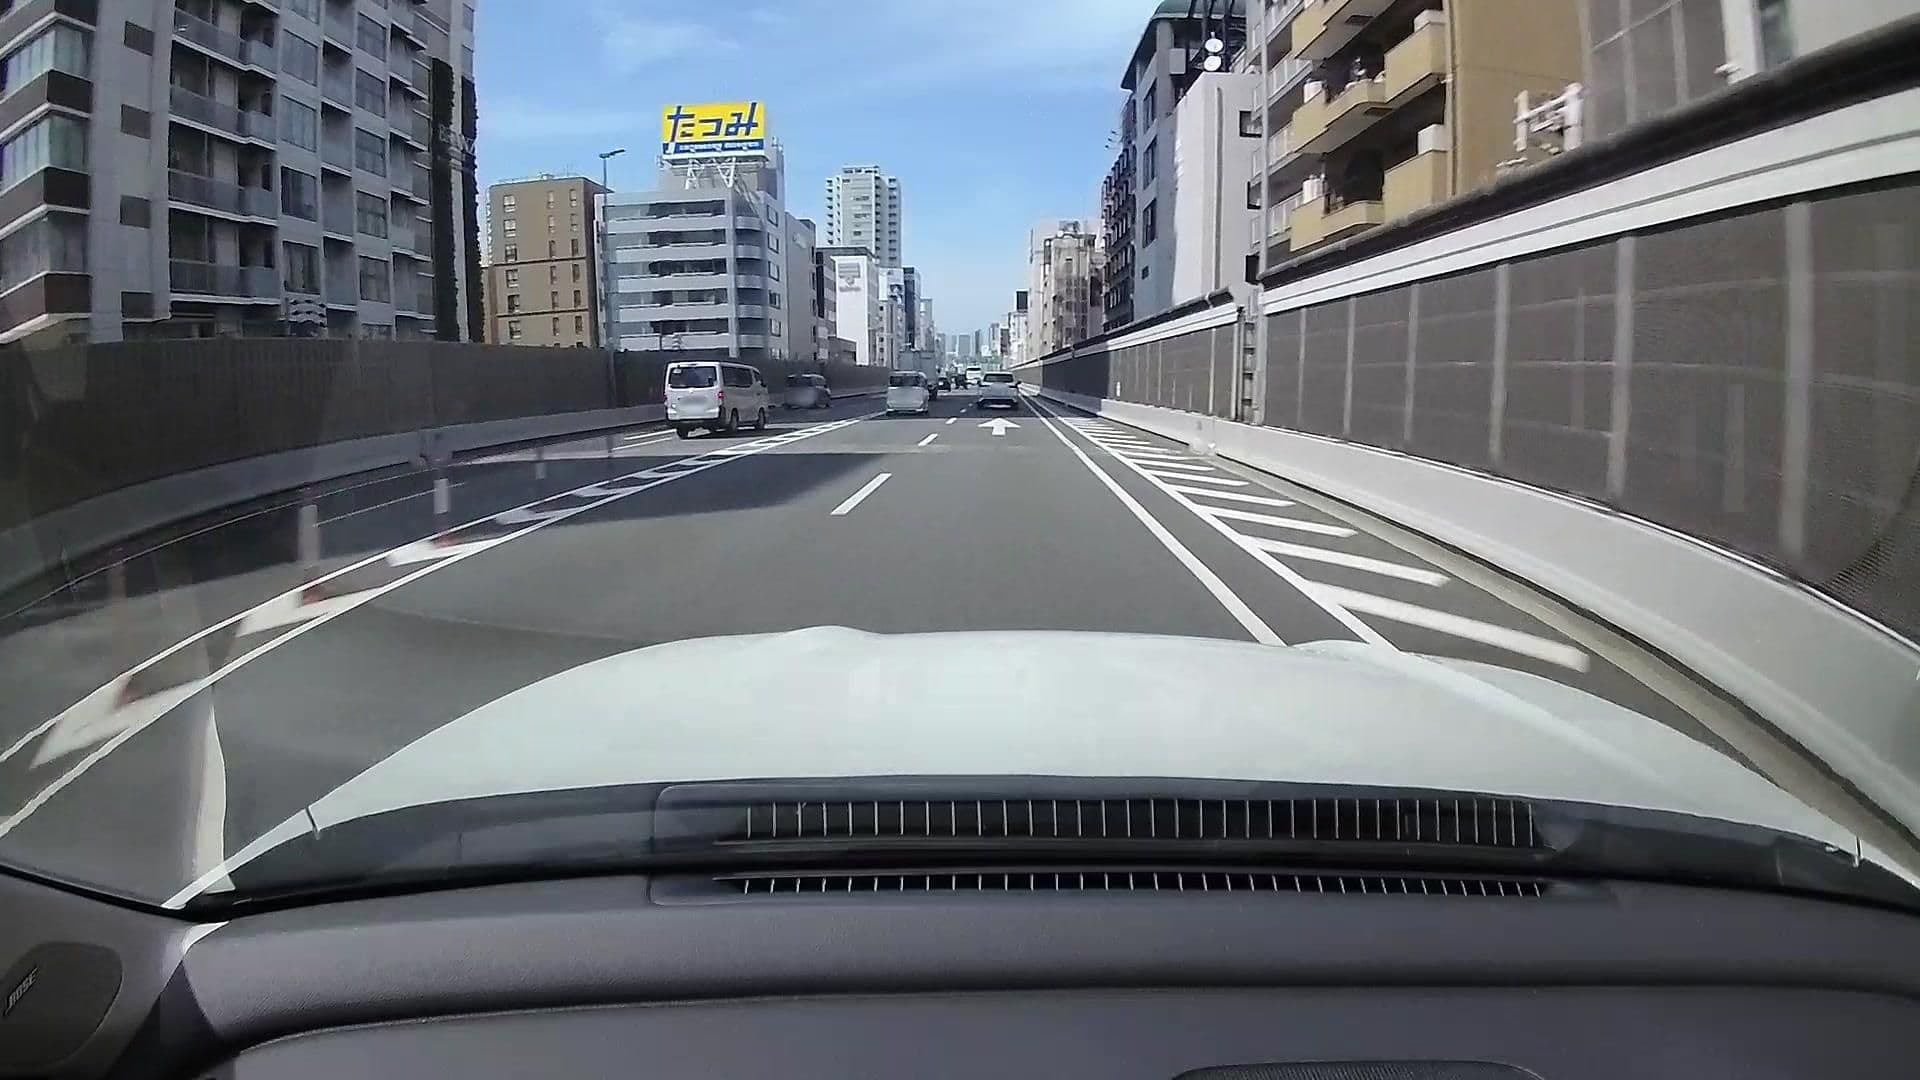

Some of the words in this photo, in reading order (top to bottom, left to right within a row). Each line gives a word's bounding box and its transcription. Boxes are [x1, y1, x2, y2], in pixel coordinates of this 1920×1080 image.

[666, 102, 758, 153] たつみ
[5, 967, 38, 1015] BOSE
